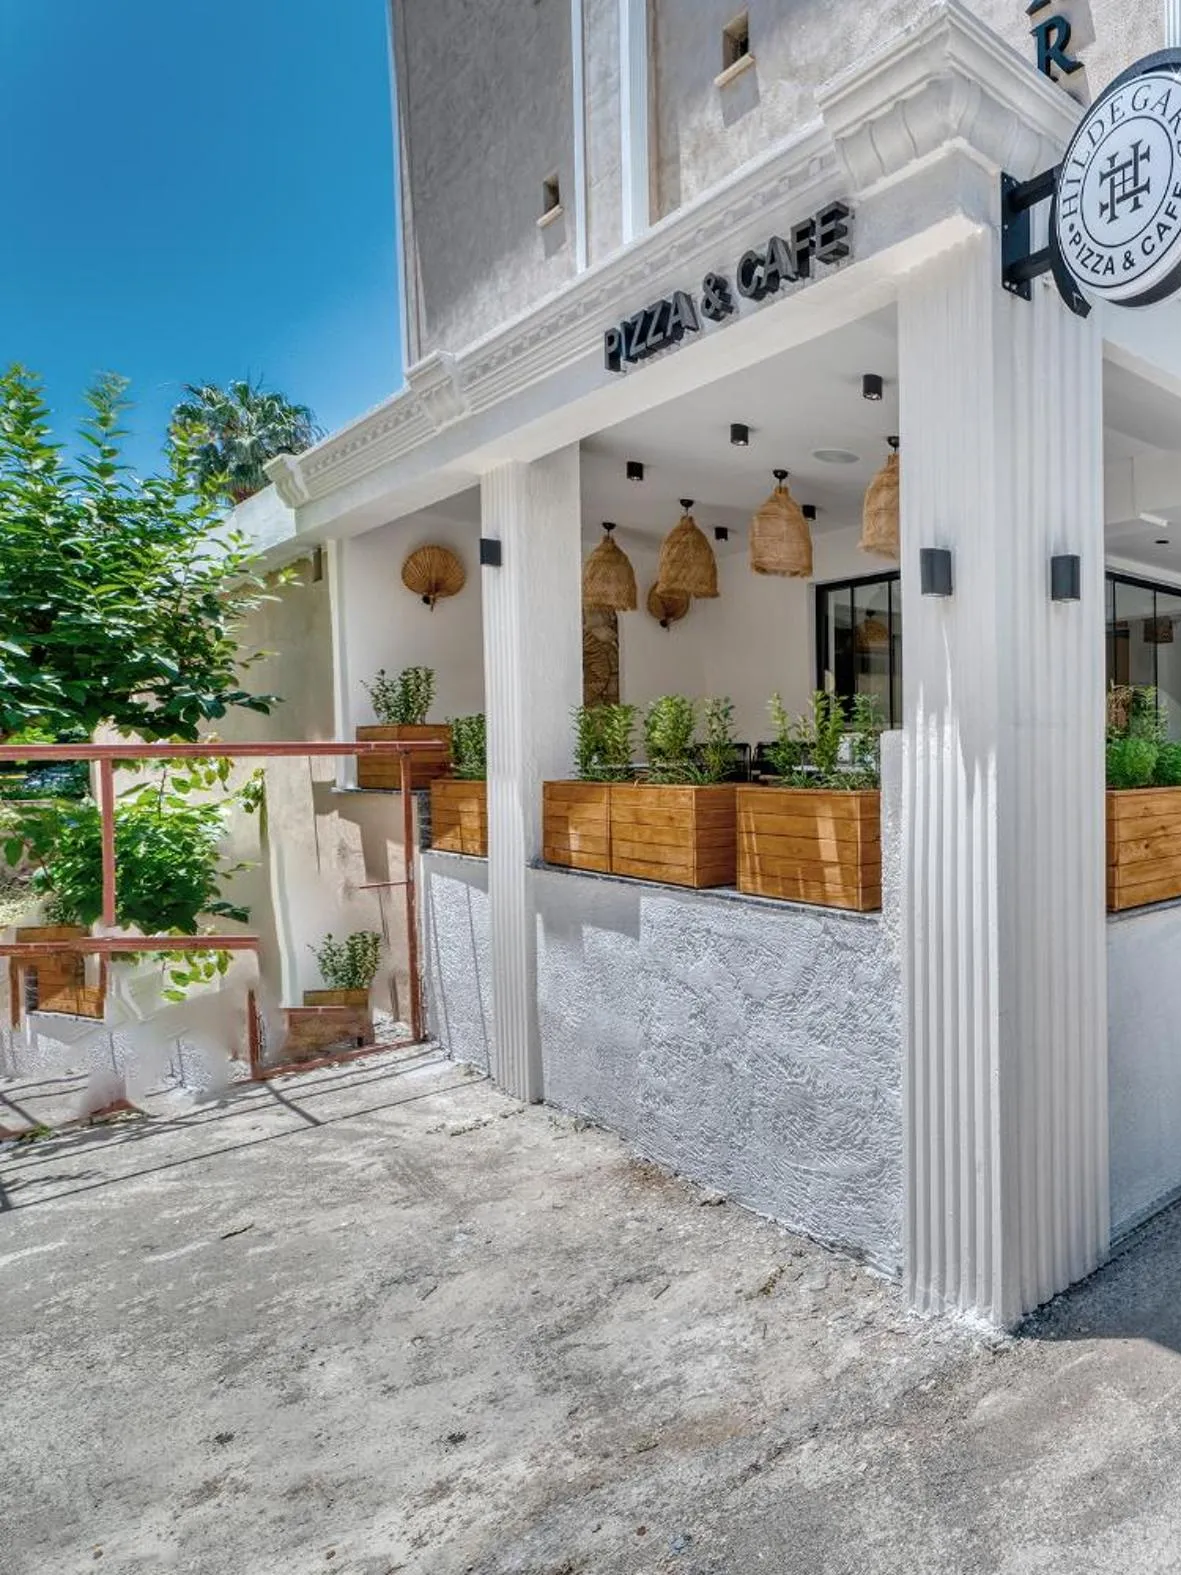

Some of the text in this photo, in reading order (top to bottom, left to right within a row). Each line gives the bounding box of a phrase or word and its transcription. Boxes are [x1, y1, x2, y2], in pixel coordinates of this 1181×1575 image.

[1025, 0, 1085, 83] R
[604, 201, 851, 373] PIZZA & CAFE
[1068, 232, 1116, 275] PIZZA
[1122, 250, 1136, 271] &
